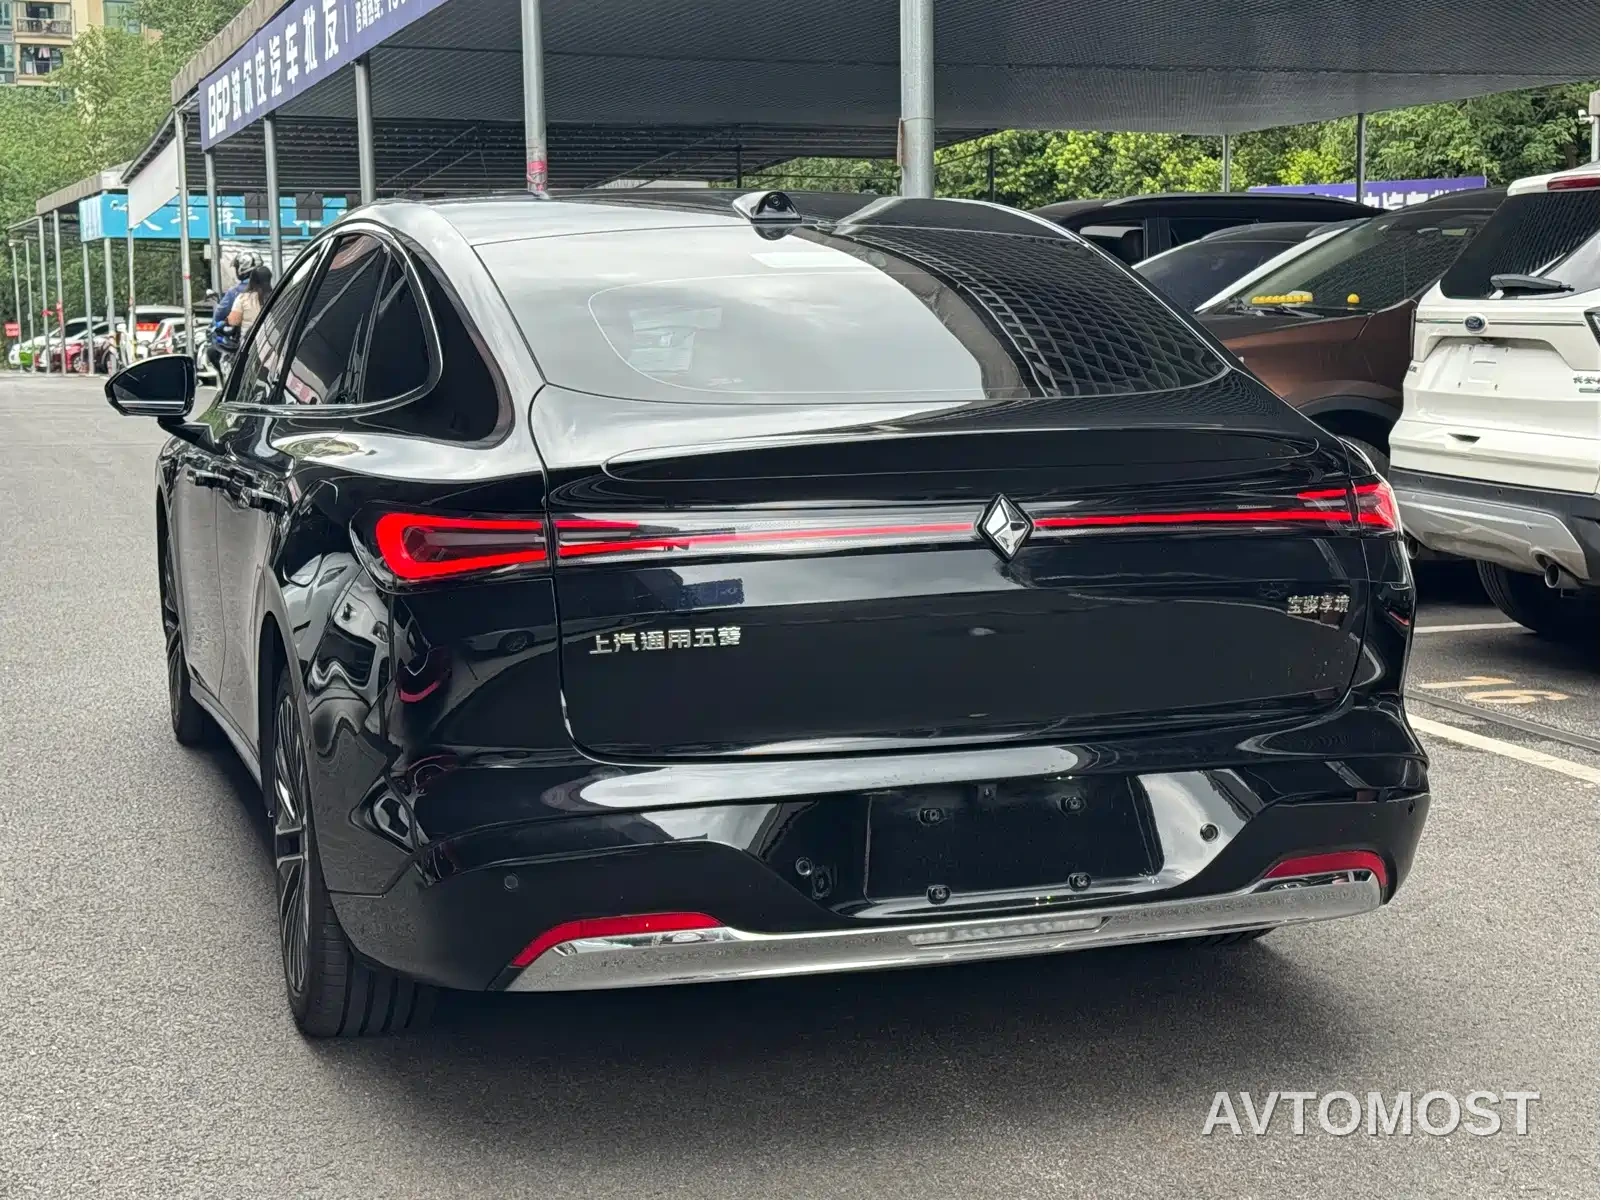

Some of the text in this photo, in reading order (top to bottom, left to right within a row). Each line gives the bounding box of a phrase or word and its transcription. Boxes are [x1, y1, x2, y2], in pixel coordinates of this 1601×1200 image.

[589, 625, 742, 655] 上汽通用五菱
